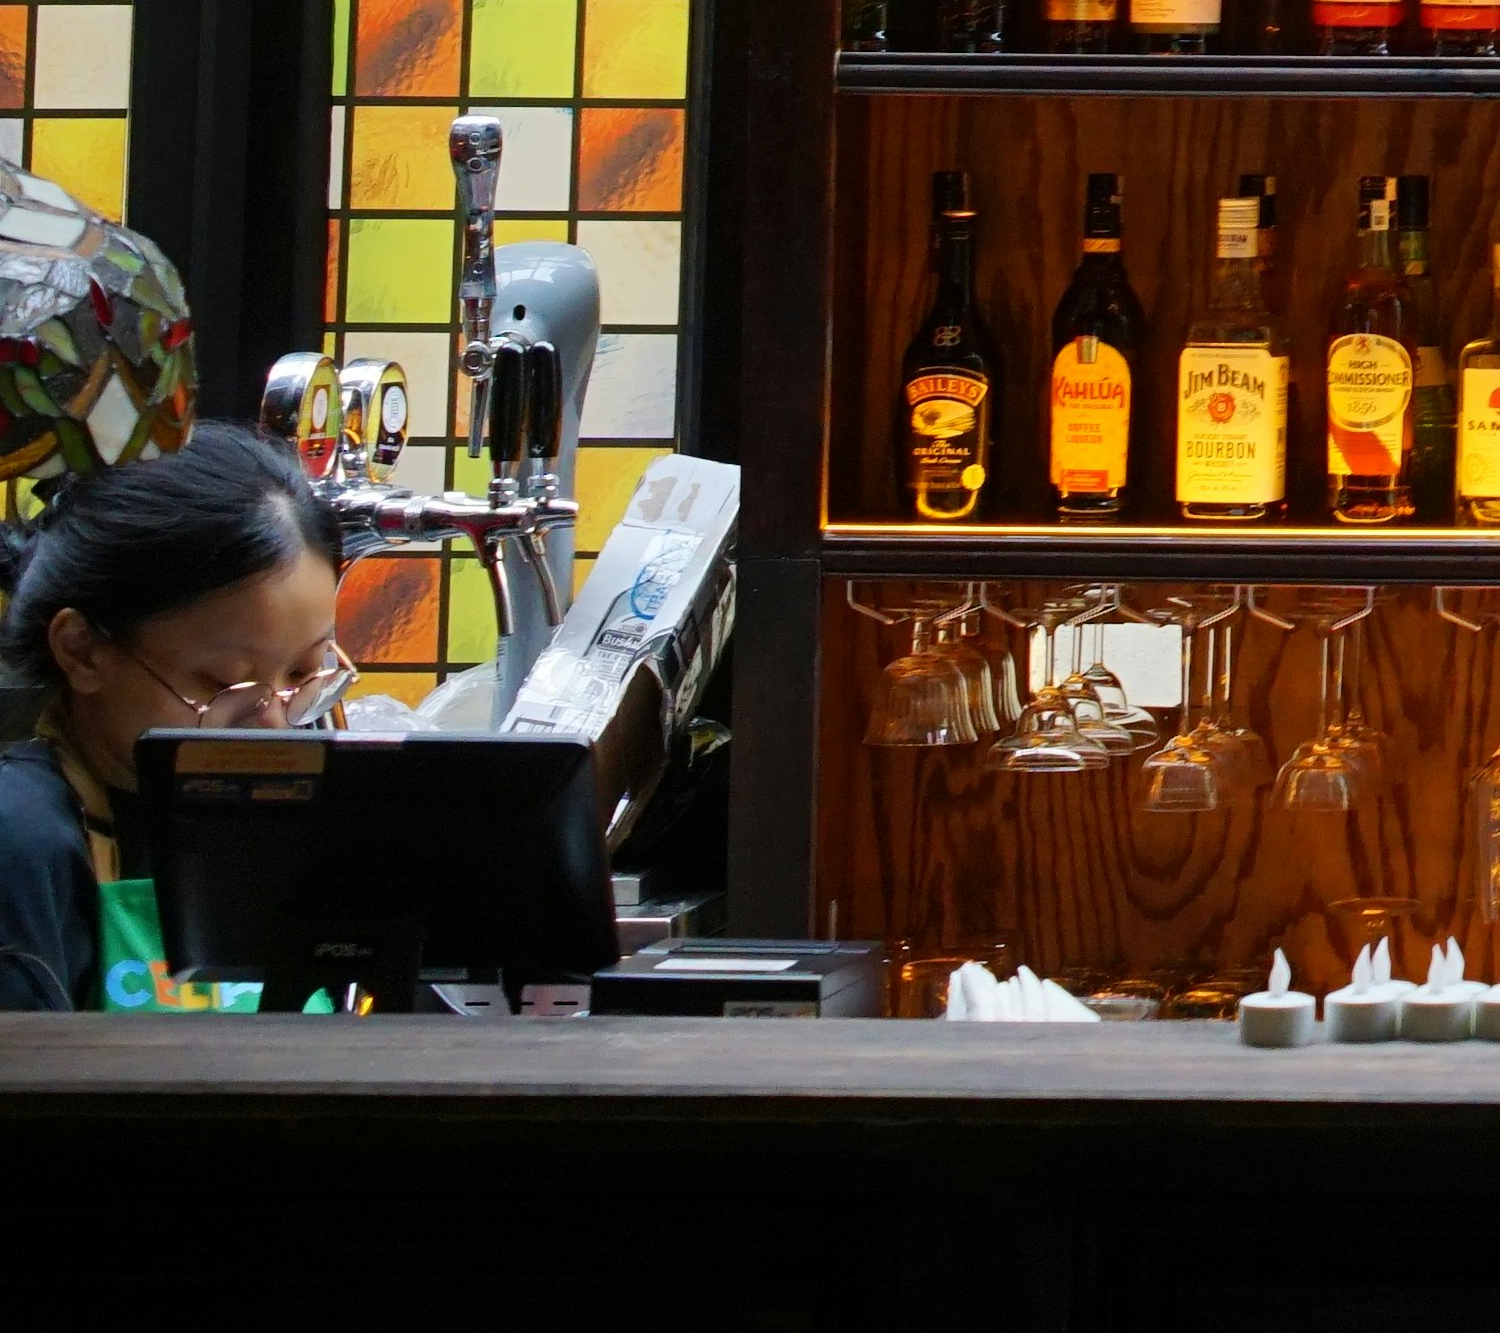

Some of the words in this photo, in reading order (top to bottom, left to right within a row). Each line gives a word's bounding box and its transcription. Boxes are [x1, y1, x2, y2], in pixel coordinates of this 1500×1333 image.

[1348, 360, 1378, 370] HIGH
[910, 377, 980, 401] BAILEYS
[1184, 369, 1214, 399] JIM
[1216, 363, 1264, 399] BEAM
[1054, 376, 1125, 409] KAHLÚA
[913, 447, 972, 456] ORIGINAL
[1186, 440, 1256, 459] BOURBON
